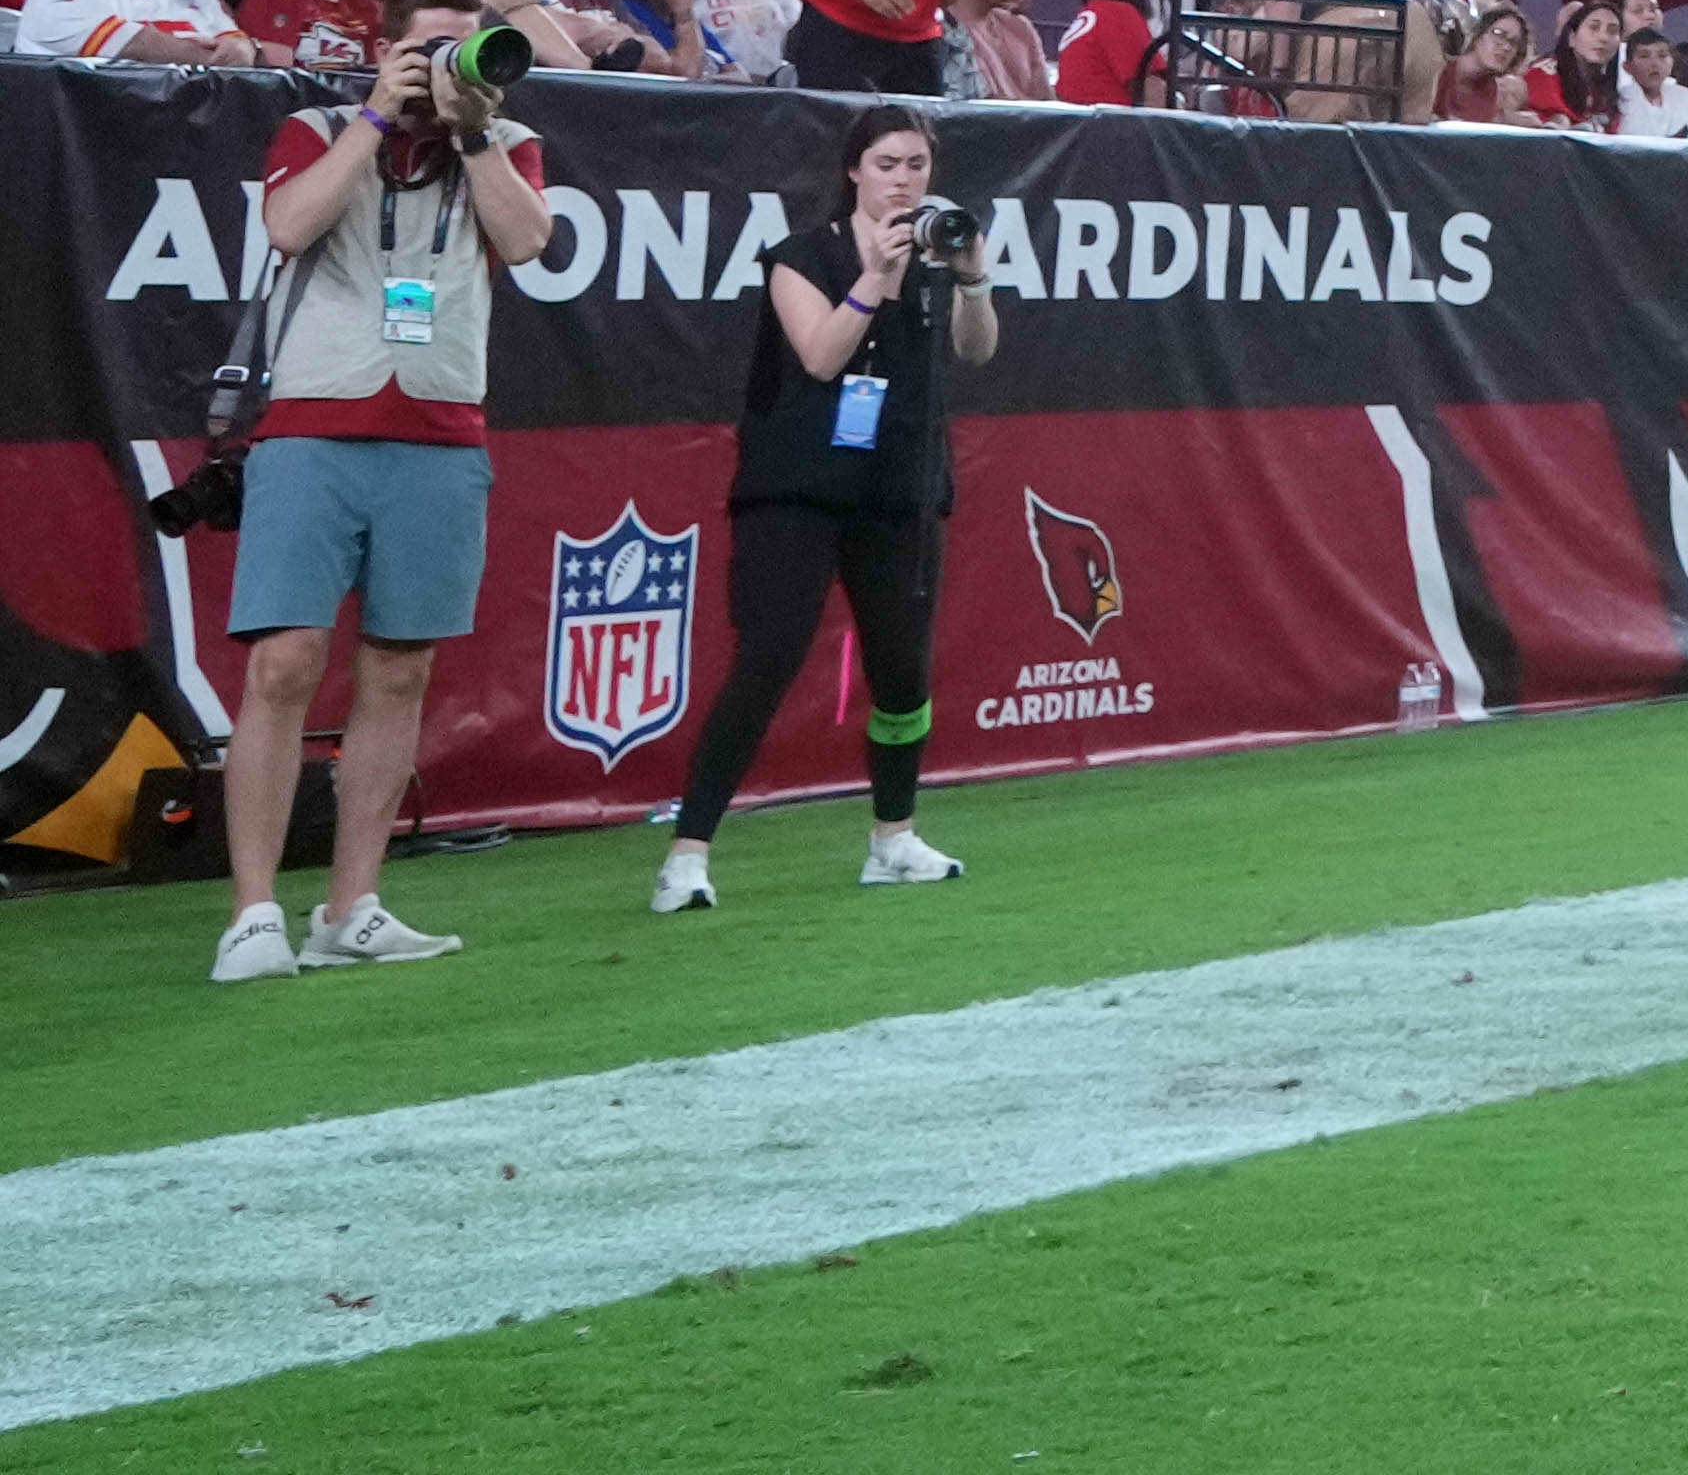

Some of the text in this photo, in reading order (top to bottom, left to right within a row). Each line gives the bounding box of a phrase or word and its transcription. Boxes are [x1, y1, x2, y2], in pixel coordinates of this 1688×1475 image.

[984, 198, 1494, 307] ARDINALS
[563, 620, 671, 732] NFL
[975, 681, 1155, 731] CARDINALS
[1015, 656, 1122, 690] ARIZONA
